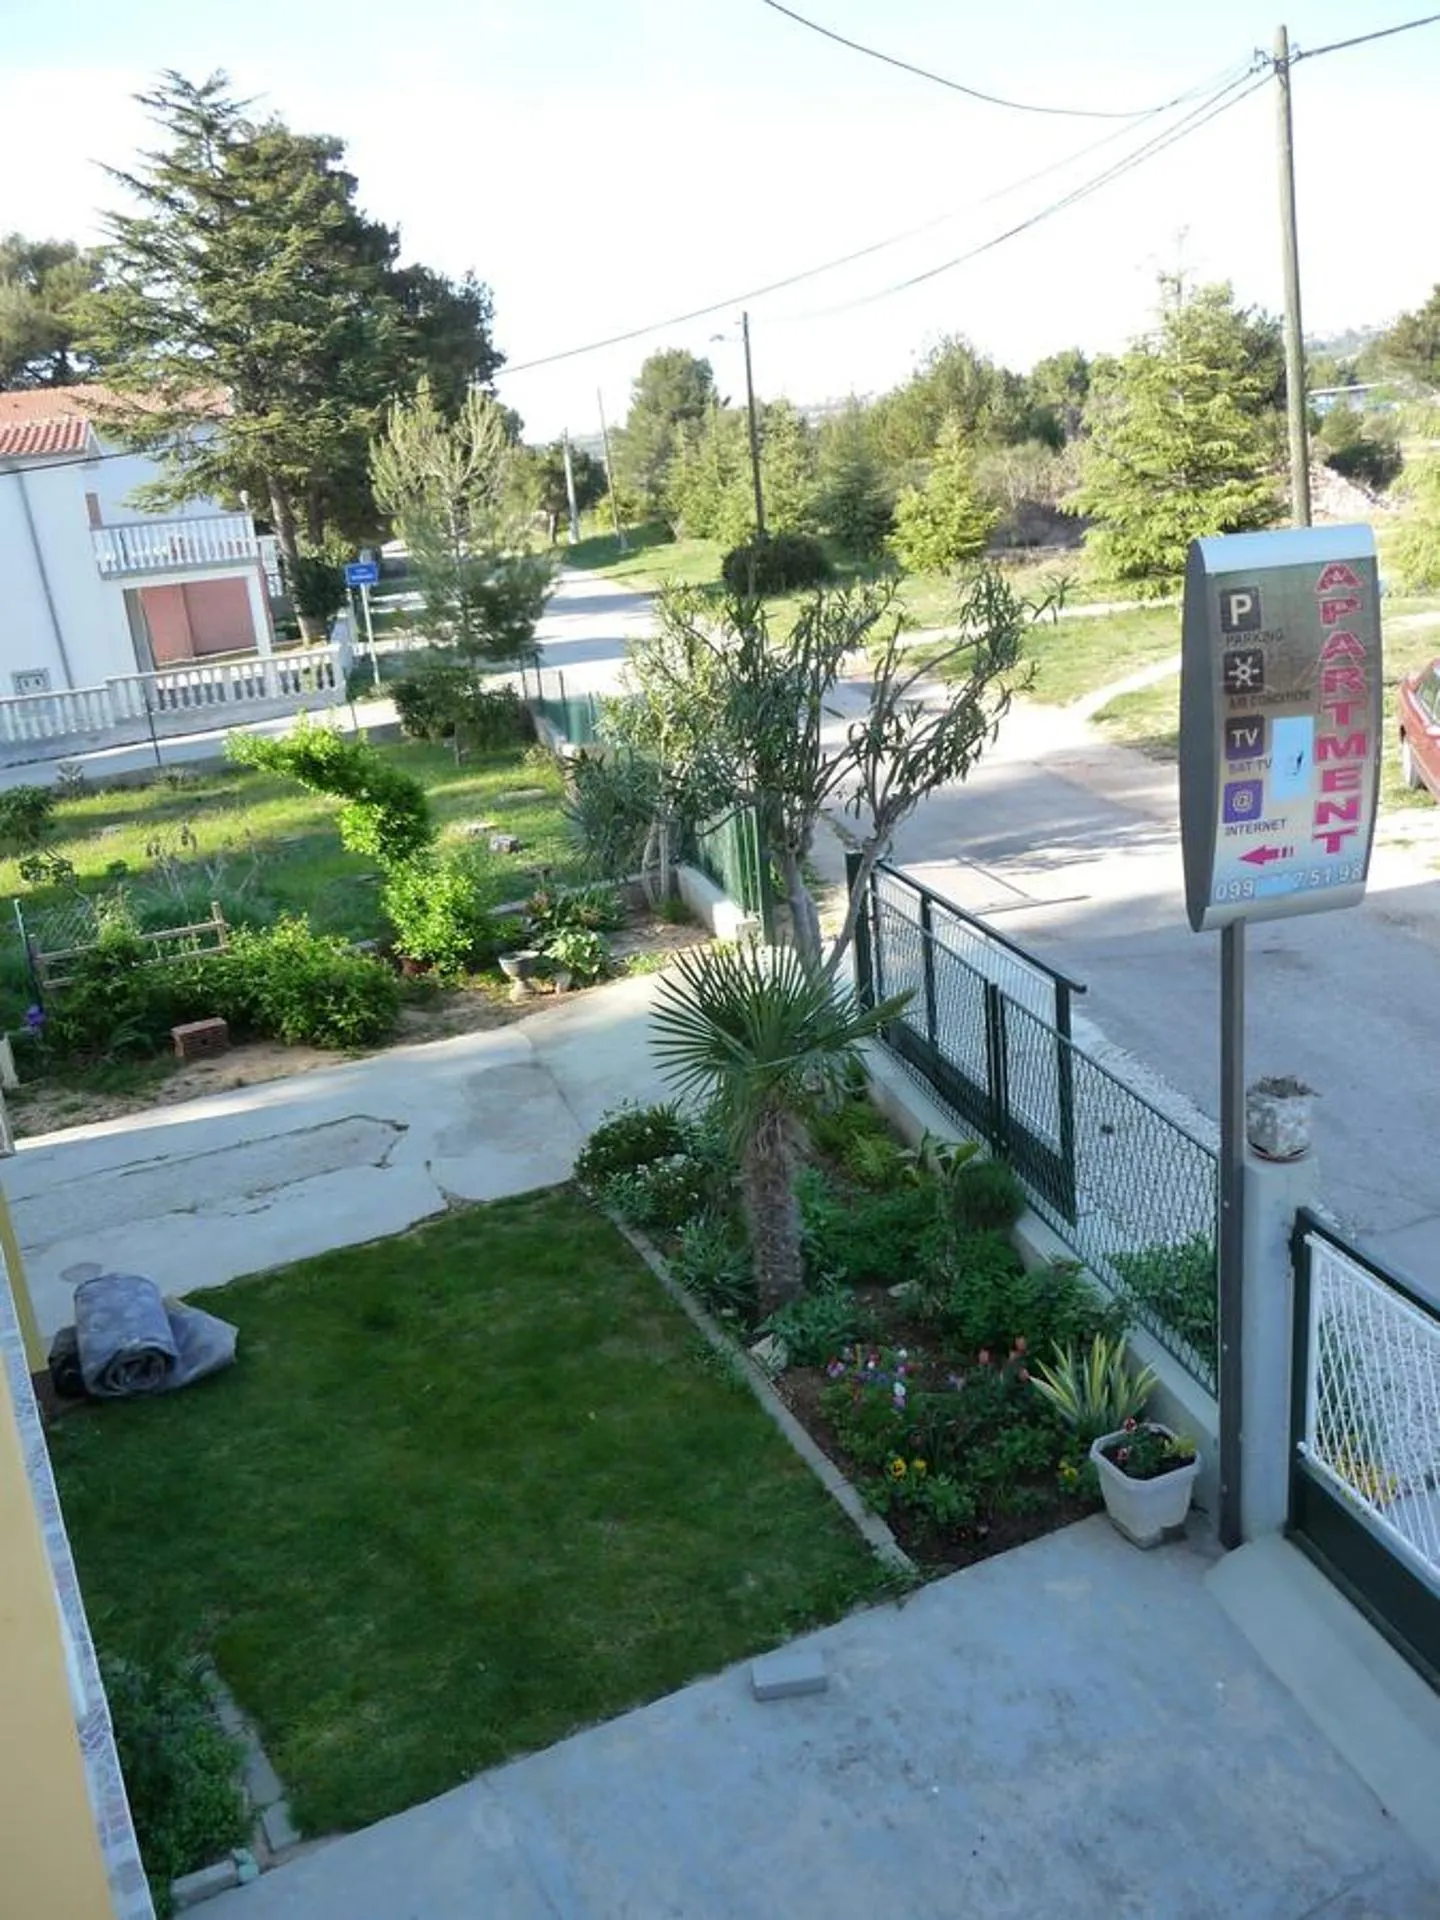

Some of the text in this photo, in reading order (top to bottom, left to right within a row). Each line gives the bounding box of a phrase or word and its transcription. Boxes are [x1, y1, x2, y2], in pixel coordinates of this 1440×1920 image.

[1230, 594, 1253, 625] P
[1226, 628, 1284, 644] PARKING
[1313, 562, 1366, 853] APARTMENT
[1232, 727, 1260, 748] TV
[1225, 818, 1287, 836] INTERNET
[1215, 878, 1253, 899] 099
